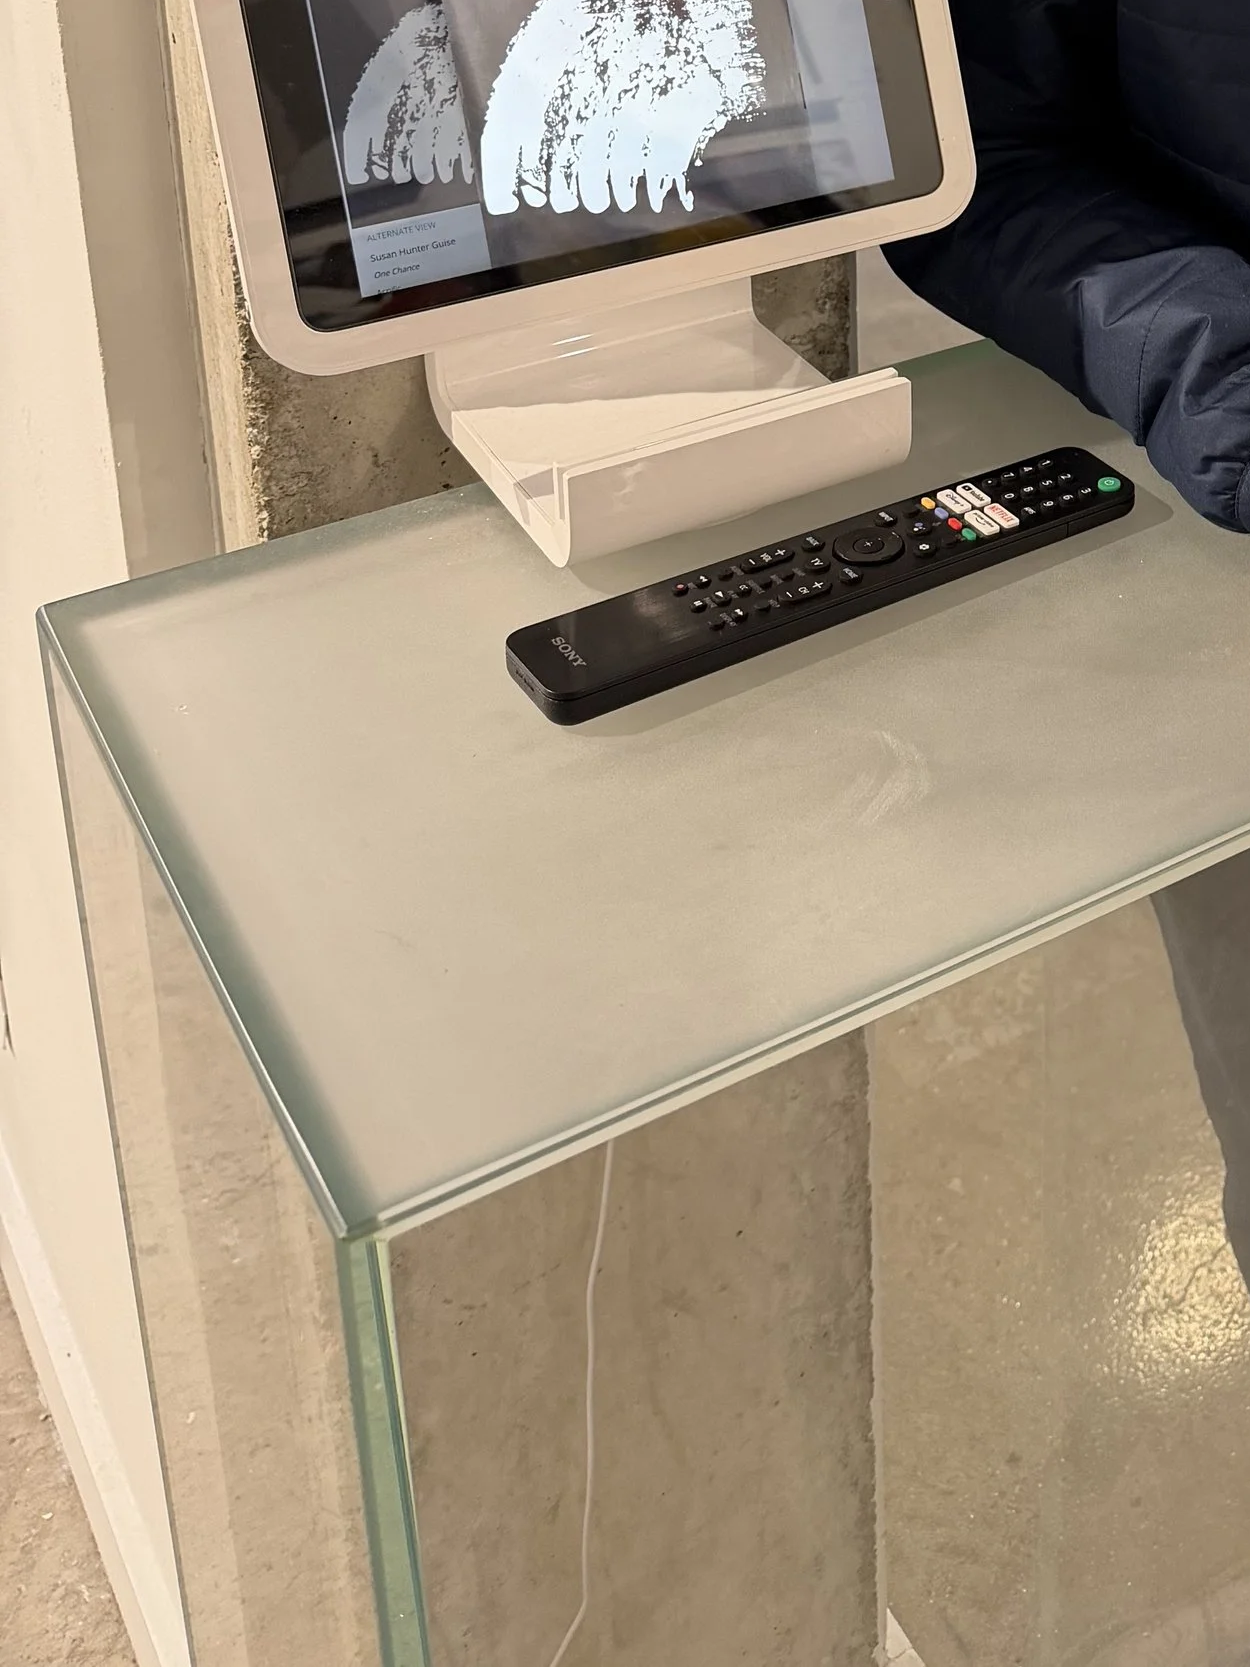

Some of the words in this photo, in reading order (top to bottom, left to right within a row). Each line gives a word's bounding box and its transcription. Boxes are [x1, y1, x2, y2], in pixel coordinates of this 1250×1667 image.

[367, 227, 414, 242] ALTERNATE
[415, 222, 437, 232] VIEW
[370, 250, 397, 263] Susan
[400, 243, 429, 256] Hunter
[432, 238, 457, 250] Guise
[374, 270, 391, 279] One
[392, 263, 421, 275] Chance
[989, 505, 1014, 523] NETFLIX
[810, 557, 823, 566] TV
[551, 636, 587, 667] SONY
